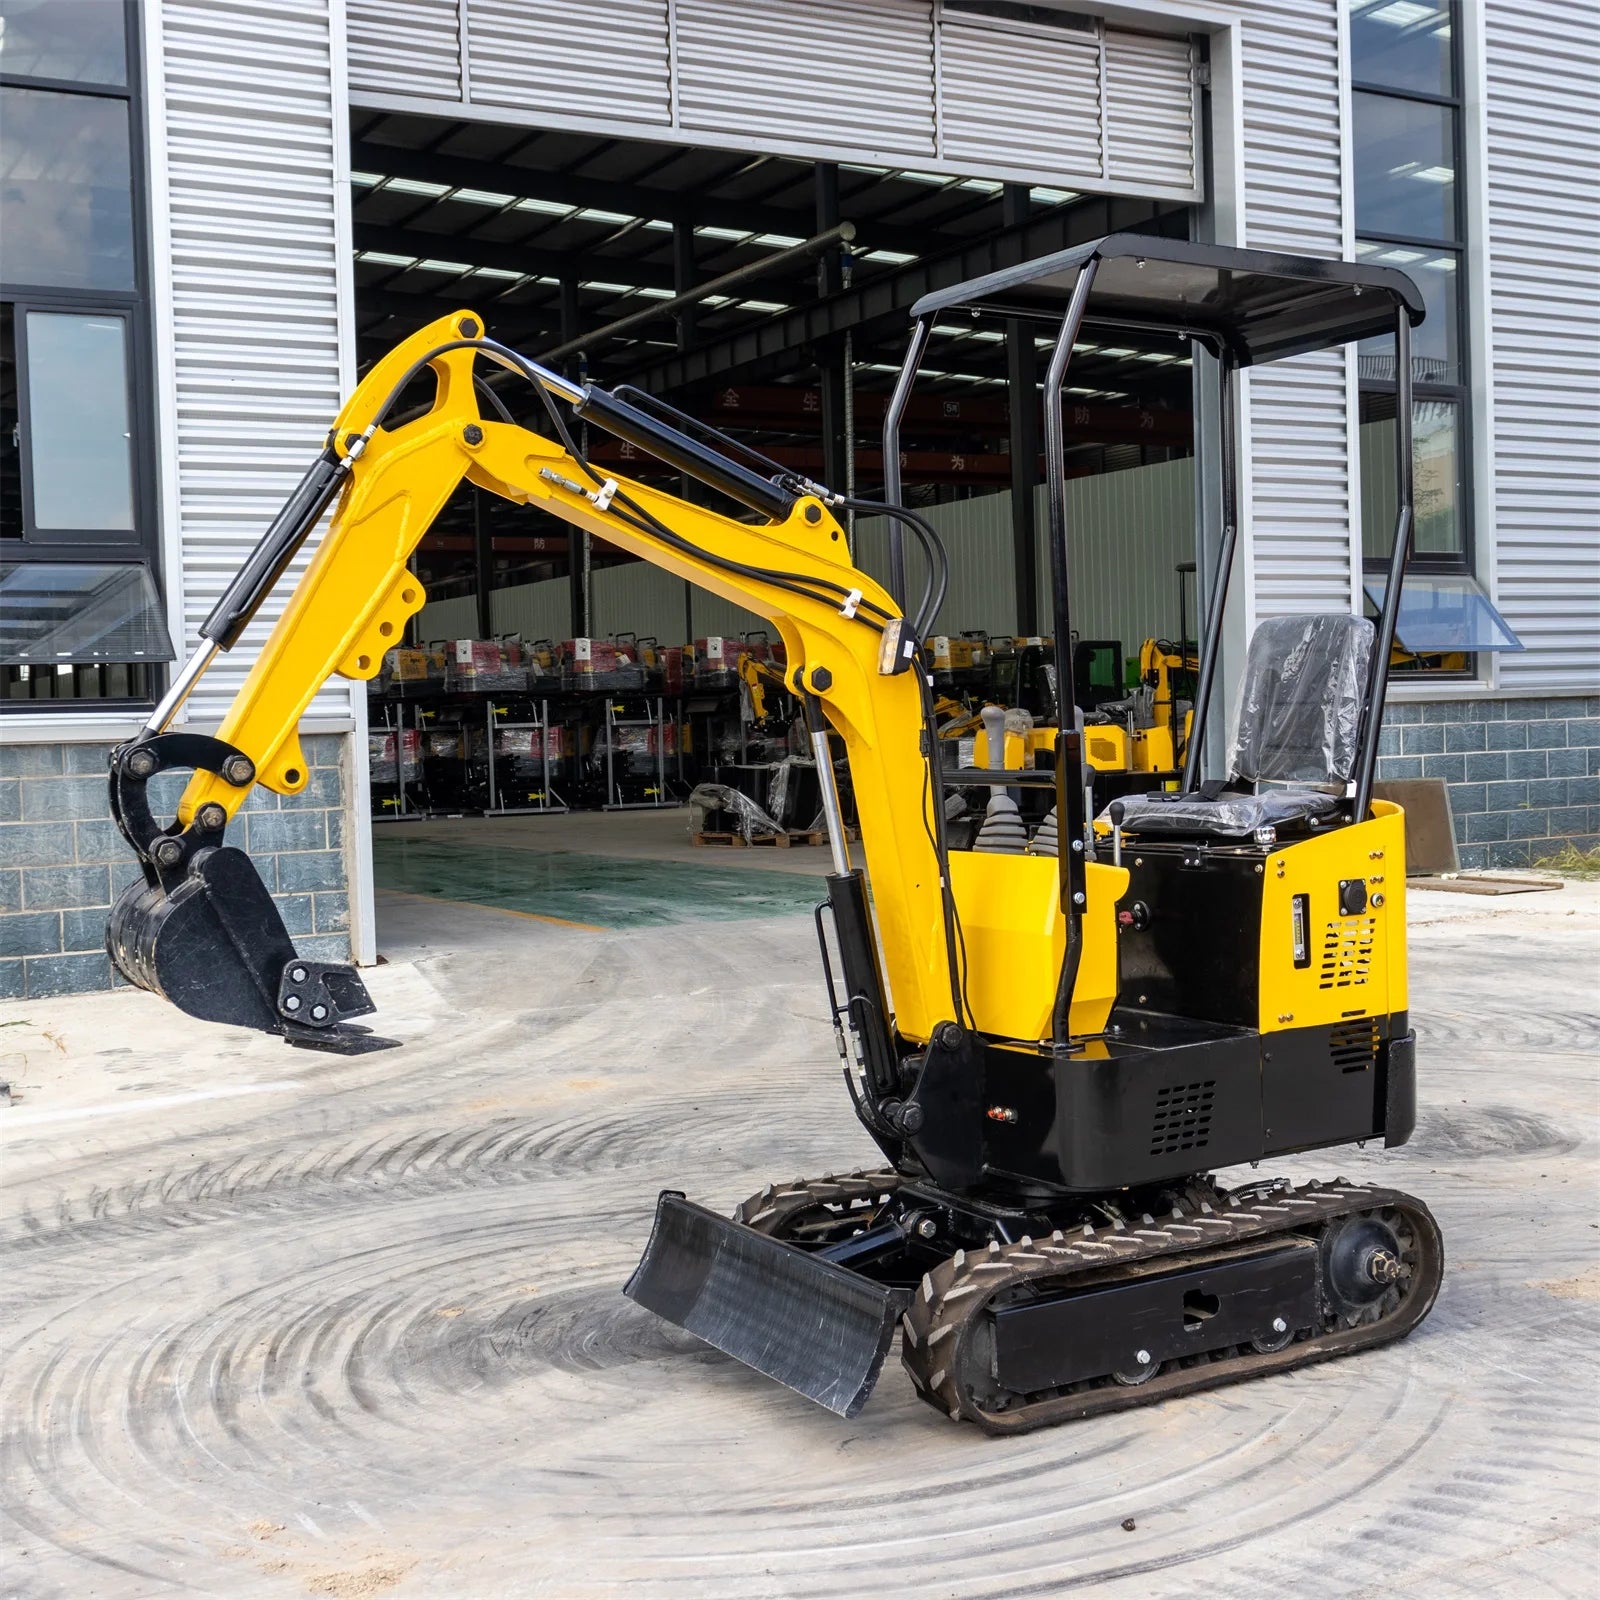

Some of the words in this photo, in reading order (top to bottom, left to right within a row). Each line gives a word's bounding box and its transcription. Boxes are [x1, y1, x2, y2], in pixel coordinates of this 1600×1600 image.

[722, 388, 740, 407] 全
[803, 392, 820, 411] 生
[1139, 411, 1154, 428] 为
[619, 441, 636, 460] 生
[951, 455, 965, 471] 为
[533, 537, 546, 551] 防
